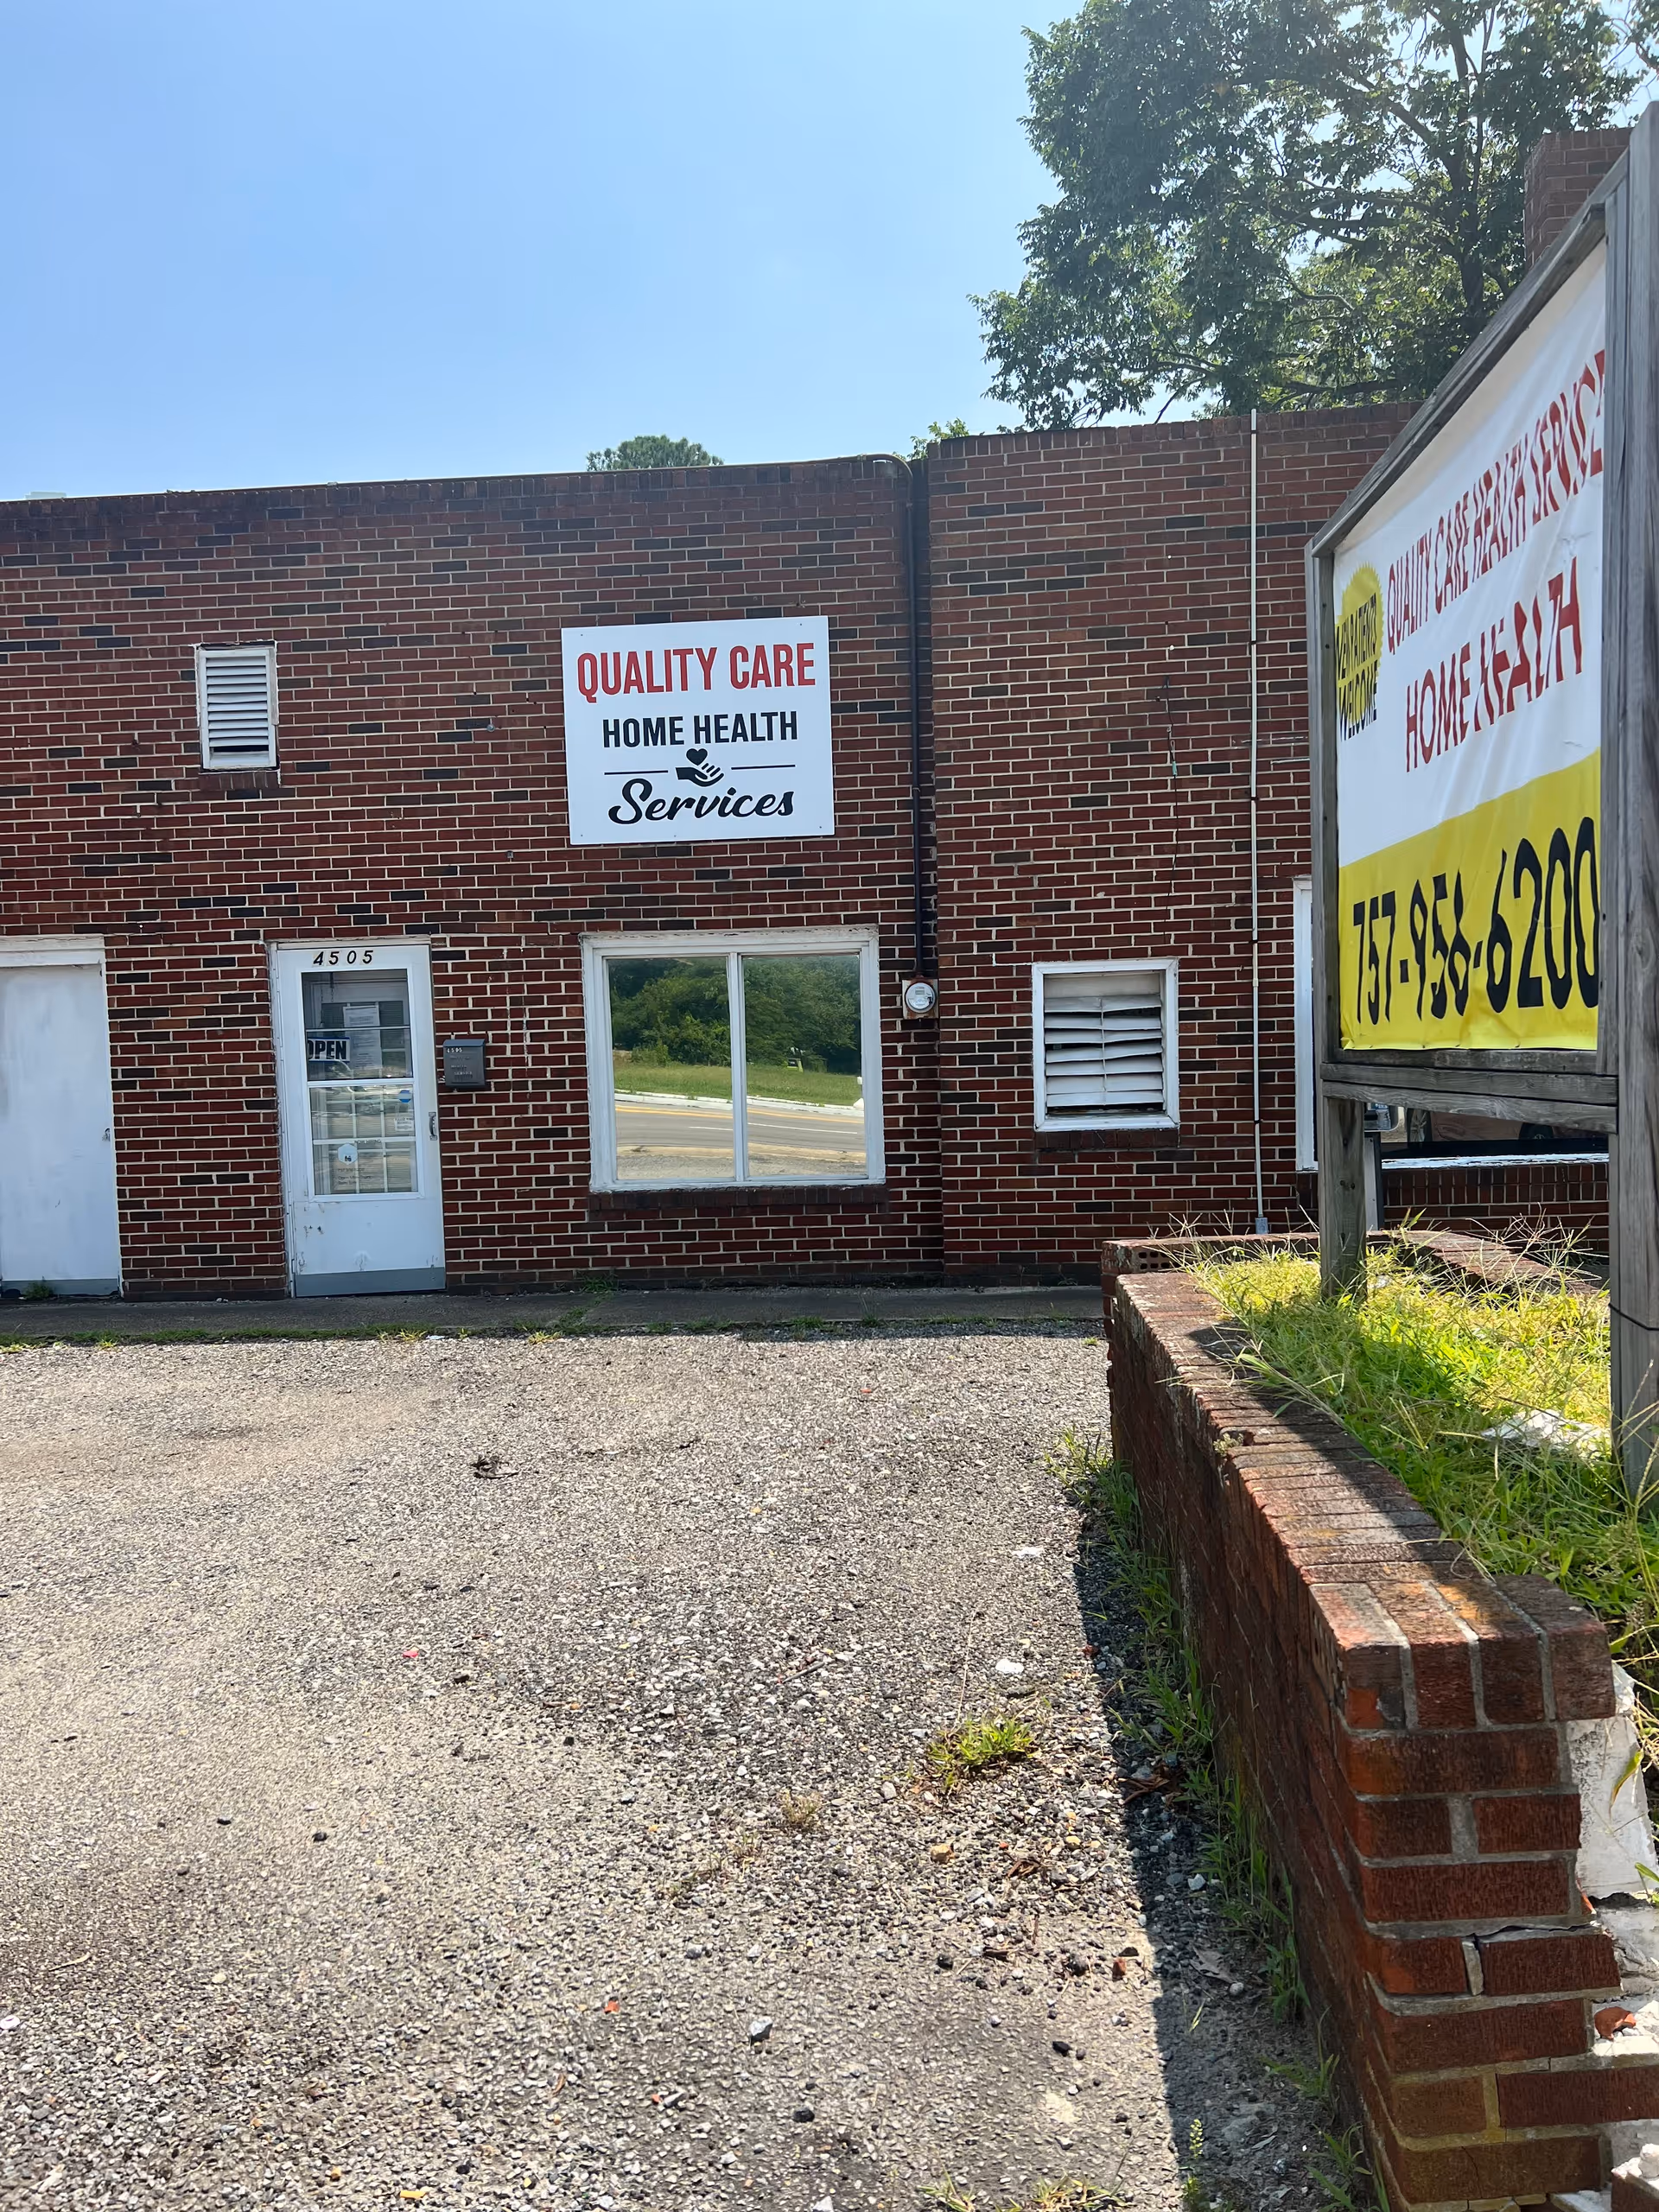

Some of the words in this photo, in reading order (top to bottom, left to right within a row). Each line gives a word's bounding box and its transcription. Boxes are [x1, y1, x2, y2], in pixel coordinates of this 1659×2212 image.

[1387, 527, 1432, 655] QUALITY
[1434, 491, 1470, 614] CARE
[1471, 433, 1529, 583] HEALTH
[577, 647, 717, 703] QUALITY
[729, 642, 816, 690] CARE
[1406, 642, 1471, 772] HOME
[1473, 556, 1582, 732] HEALTH
[602, 715, 685, 748] HOME
[693, 710, 798, 744] HEALTH
[1339, 659, 1378, 742] WELCOME
[607, 778, 795, 824] Services
[313, 950, 373, 965] 4505
